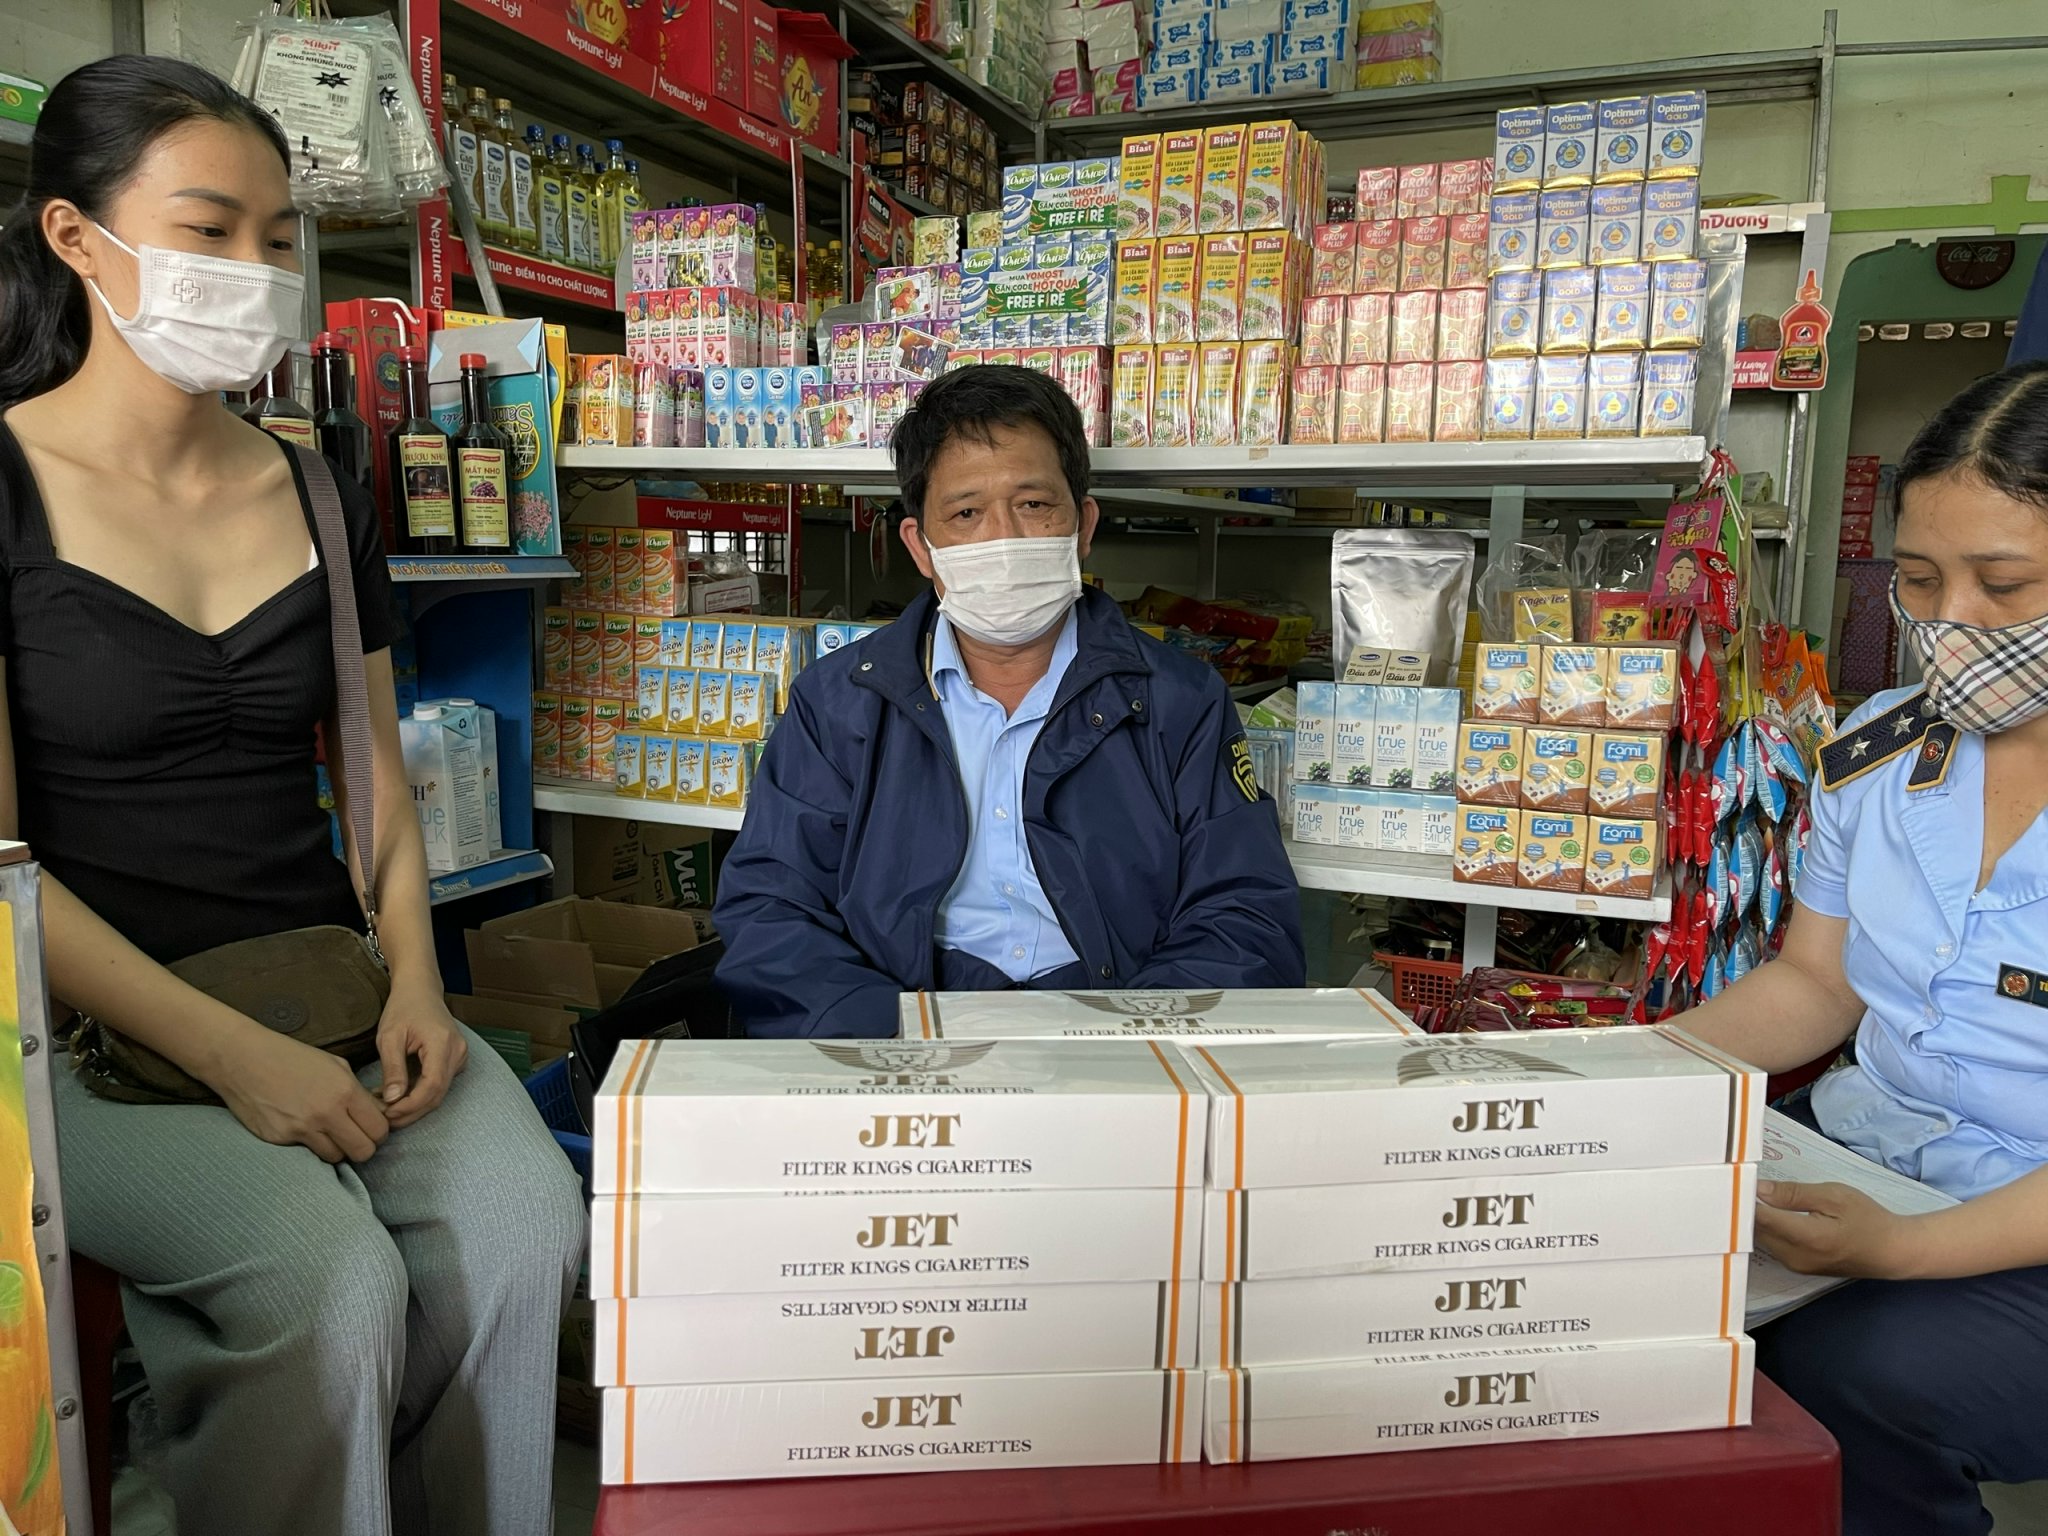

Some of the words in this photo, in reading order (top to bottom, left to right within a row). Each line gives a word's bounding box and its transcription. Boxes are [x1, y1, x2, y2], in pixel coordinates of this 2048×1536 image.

[567, 29, 604, 59] Neptune
[420, 36, 433, 104] Neptune
[659, 77, 691, 104] Neptune
[1604, 109, 1645, 120] Optimum
[1658, 104, 1700, 115] Optimum
[1502, 118, 1542, 128] Optimum
[1552, 113, 1592, 124] Optimum
[738, 117, 766, 139] Neptune
[1067, 187, 1104, 197] YOMOST
[1545, 200, 1586, 209] Optimum
[1049, 211, 1075, 225] FREE
[1078, 209, 1104, 223] FIRE
[1412, 227, 1438, 235] GROW
[1459, 223, 1485, 232] GROW
[1323, 233, 1348, 241] GROW
[1366, 229, 1392, 238] GROW
[1463, 231, 1480, 239] PLUS
[430, 216, 443, 283] Neptune
[488, 260, 512, 275] tune
[537, 272, 545, 283] 10
[547, 275, 563, 287] CHO
[1025, 270, 1064, 280] YOMOST
[1013, 283, 1032, 291] CODE
[1006, 295, 1035, 308] FREE
[1037, 293, 1065, 307] FIRE
[1738, 373, 1748, 383] AN
[484, 467, 500, 475] NHO
[666, 506, 697, 520] Neptune
[743, 512, 769, 524] Neptune
[758, 648, 781, 658] GROW
[734, 687, 755, 696] GROW
[1300, 720, 1314, 730] TH
[1338, 723, 1354, 733] TH
[1298, 732, 1324, 743] true
[1337, 734, 1365, 746] true
[1337, 745, 1364, 753] YOGURT
[712, 756, 734, 766] GROW
[410, 785, 425, 800] H
[1298, 802, 1313, 811] TH
[1340, 806, 1354, 816] TH
[1297, 812, 1322, 823] true
[1339, 817, 1364, 828] true
[1297, 822, 1322, 832] MILK
[1338, 826, 1364, 837] MILK
[1122, 1017, 1207, 1028] JET
[1176, 1027, 1277, 1035] CIGARETTES
[859, 1074, 959, 1086] JET
[785, 1087, 849, 1095] FILTER
[919, 1086, 1035, 1094] CIGARETTES
[1452, 1097, 1545, 1133] JET
[858, 1113, 961, 1148] JET
[1384, 1150, 1442, 1165] FILTER
[1444, 1147, 1501, 1162] KINGS
[1504, 1141, 1609, 1159] CIGARETTES
[782, 1162, 847, 1176] FILTER
[852, 1160, 912, 1175] KINGS
[917, 1159, 1033, 1174] CIGARETTES
[1442, 1193, 1534, 1229] JET
[856, 1212, 959, 1249] JET
[1374, 1242, 1434, 1258] FILTER
[1436, 1238, 1491, 1255] KINGS
[1494, 1233, 1600, 1252] CIGARETTES
[780, 1262, 846, 1278] FILTER
[850, 1259, 910, 1275] KINGS
[914, 1256, 1030, 1272] CIGARETTES
[1434, 1277, 1527, 1313] JET
[781, 1300, 898, 1317] CIGARETTES
[903, 1299, 961, 1313] KINGS
[967, 1298, 1028, 1312] FILTER
[1367, 1328, 1426, 1345] FILTER
[1428, 1323, 1484, 1342] KINGS
[1486, 1318, 1591, 1337] CIGARETTES
[854, 1326, 955, 1360] JET
[1444, 1371, 1536, 1408] JET
[861, 1393, 962, 1429] JET
[1377, 1422, 1435, 1438] FILTER
[1439, 1418, 1493, 1434] KINGS
[1496, 1410, 1600, 1429] CIGARETTES
[787, 1447, 851, 1461] FILTER
[855, 1444, 914, 1458] KINGS
[919, 1440, 1032, 1455] CIGARETTES
